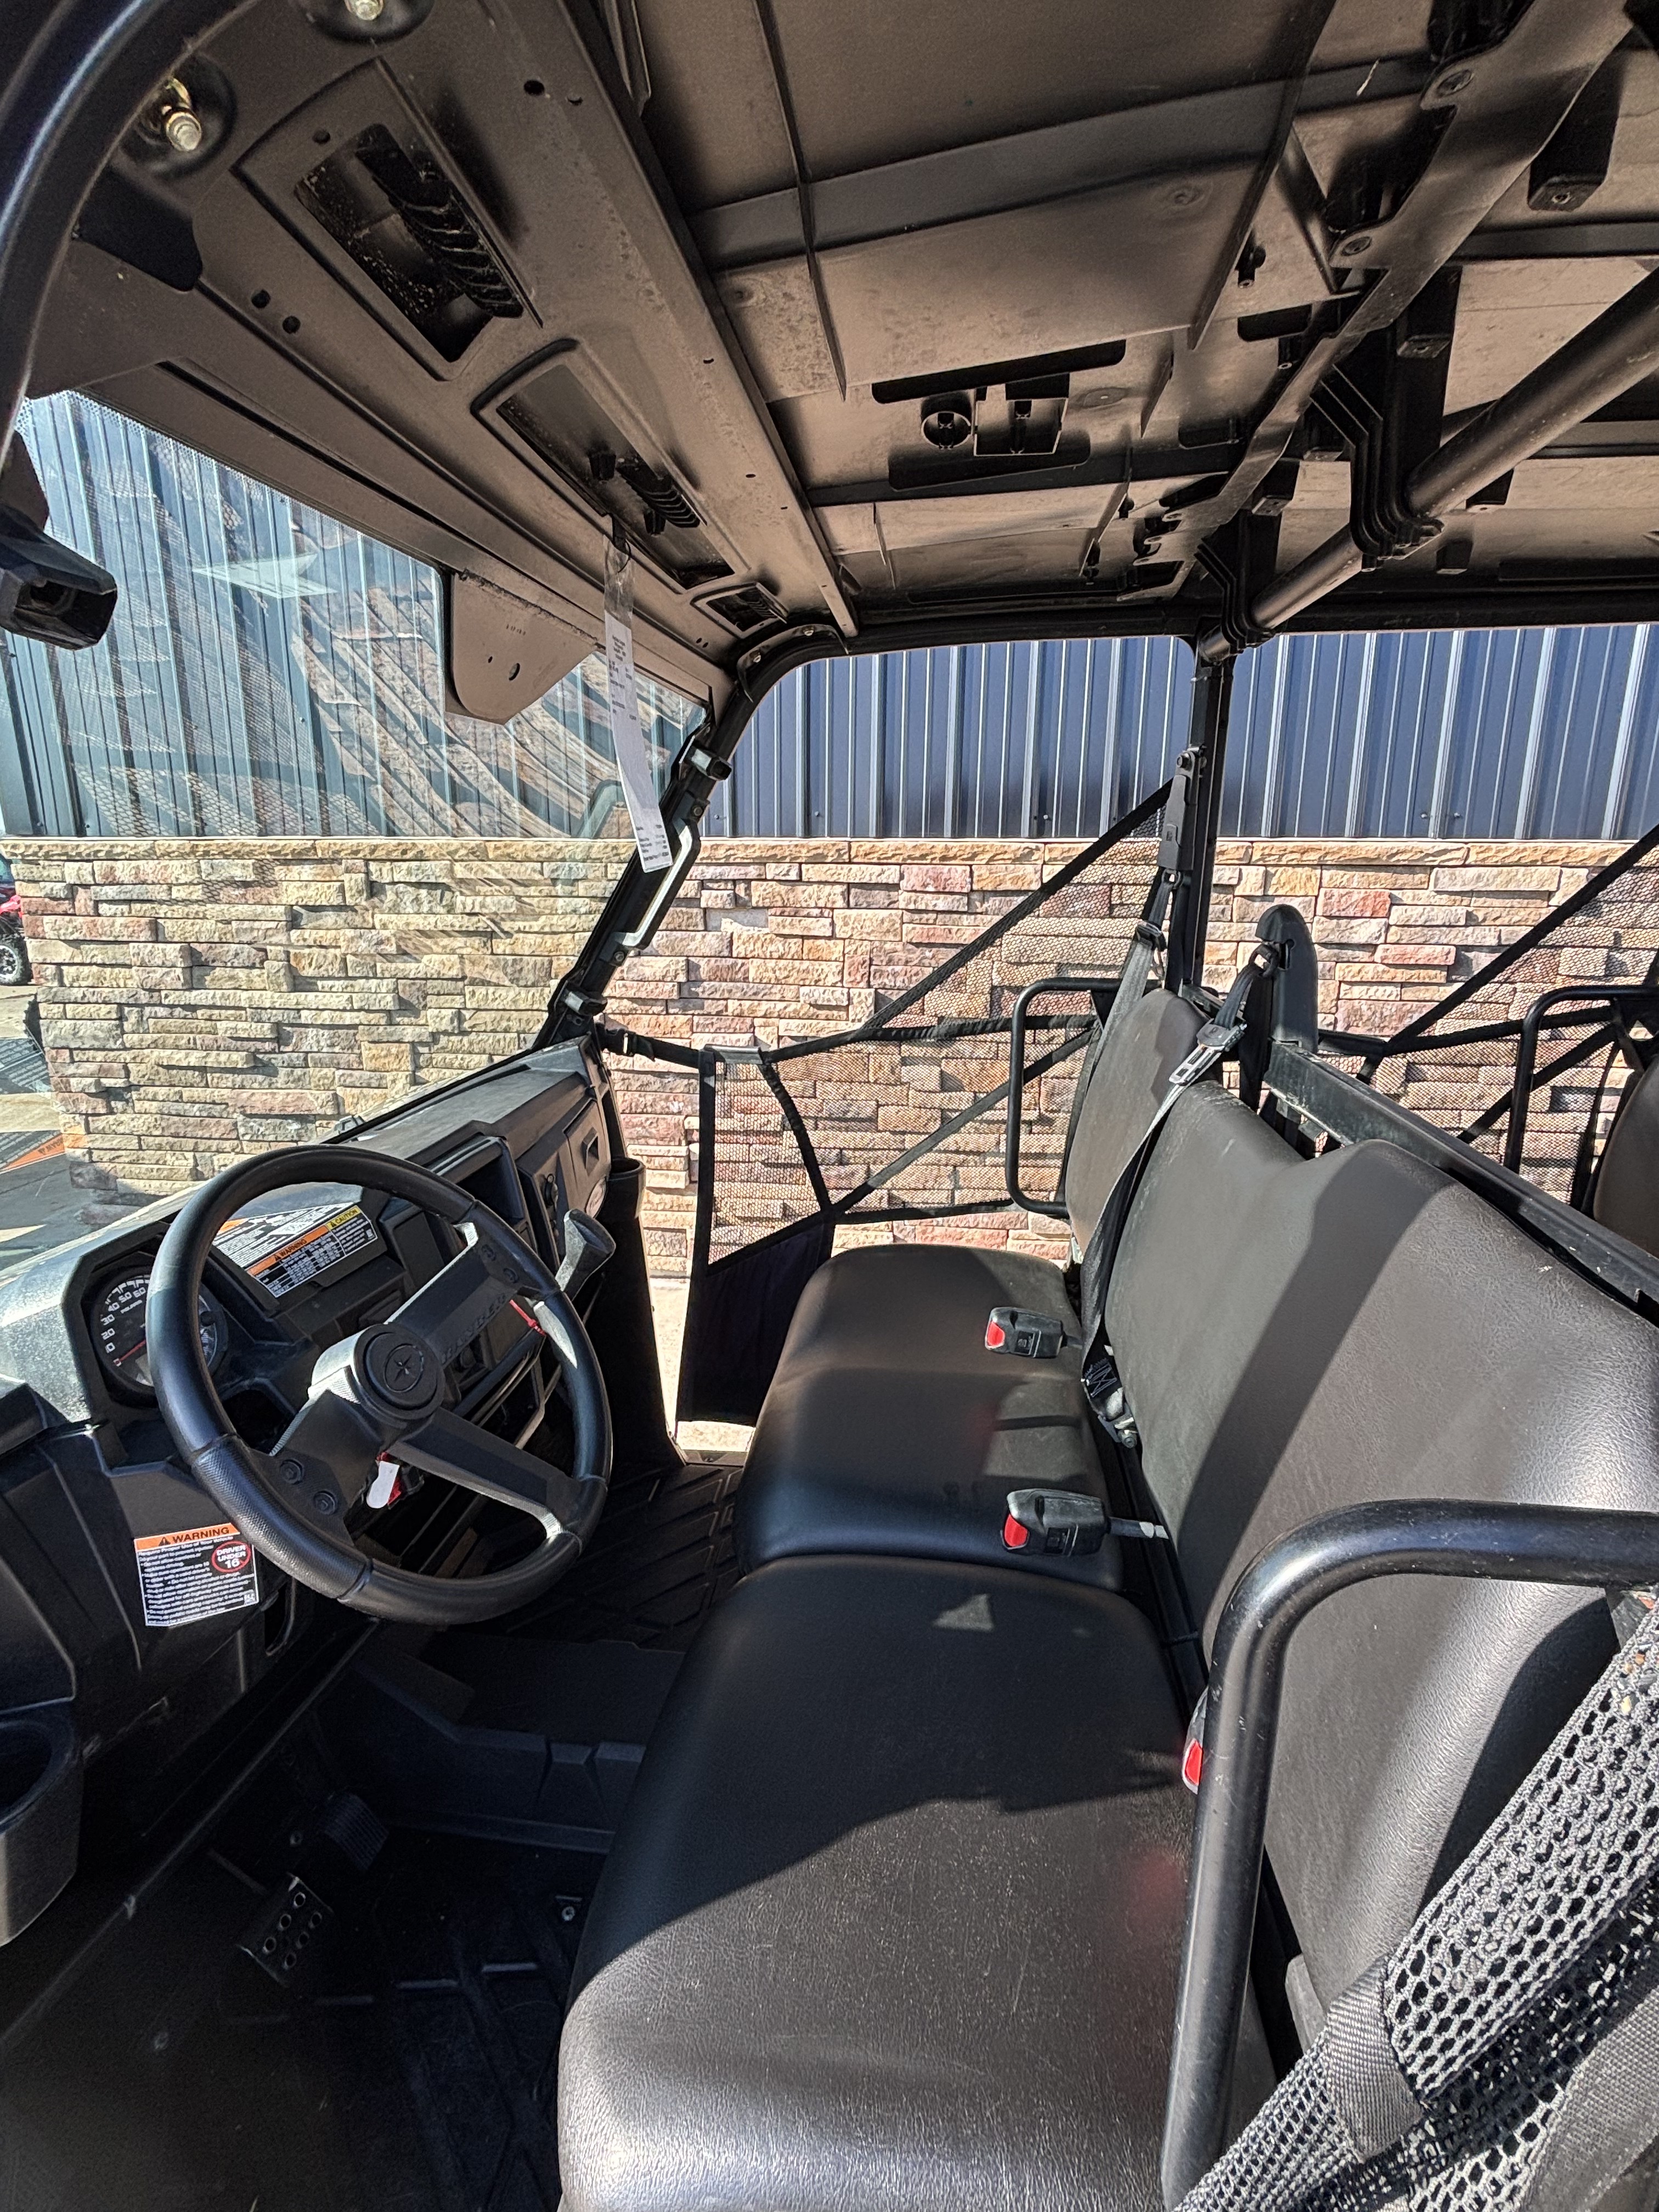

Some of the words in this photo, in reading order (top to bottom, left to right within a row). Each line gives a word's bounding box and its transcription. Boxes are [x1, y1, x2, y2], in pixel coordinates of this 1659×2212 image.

[335, 1209, 358, 1223] CAUTION
[279, 1239, 307, 1256] WARNING
[119, 1291, 132, 1303] 50
[133, 1287, 146, 1298] 60
[108, 1302, 120, 1312] 40
[100, 1314, 115, 1325] 30
[101, 1328, 115, 1340] 20
[172, 1527, 229, 1544] WARNING
[216, 1544, 246, 1556] DRIVER
[217, 1551, 246, 1562] UNDER
[224, 1558, 240, 1568] 16
